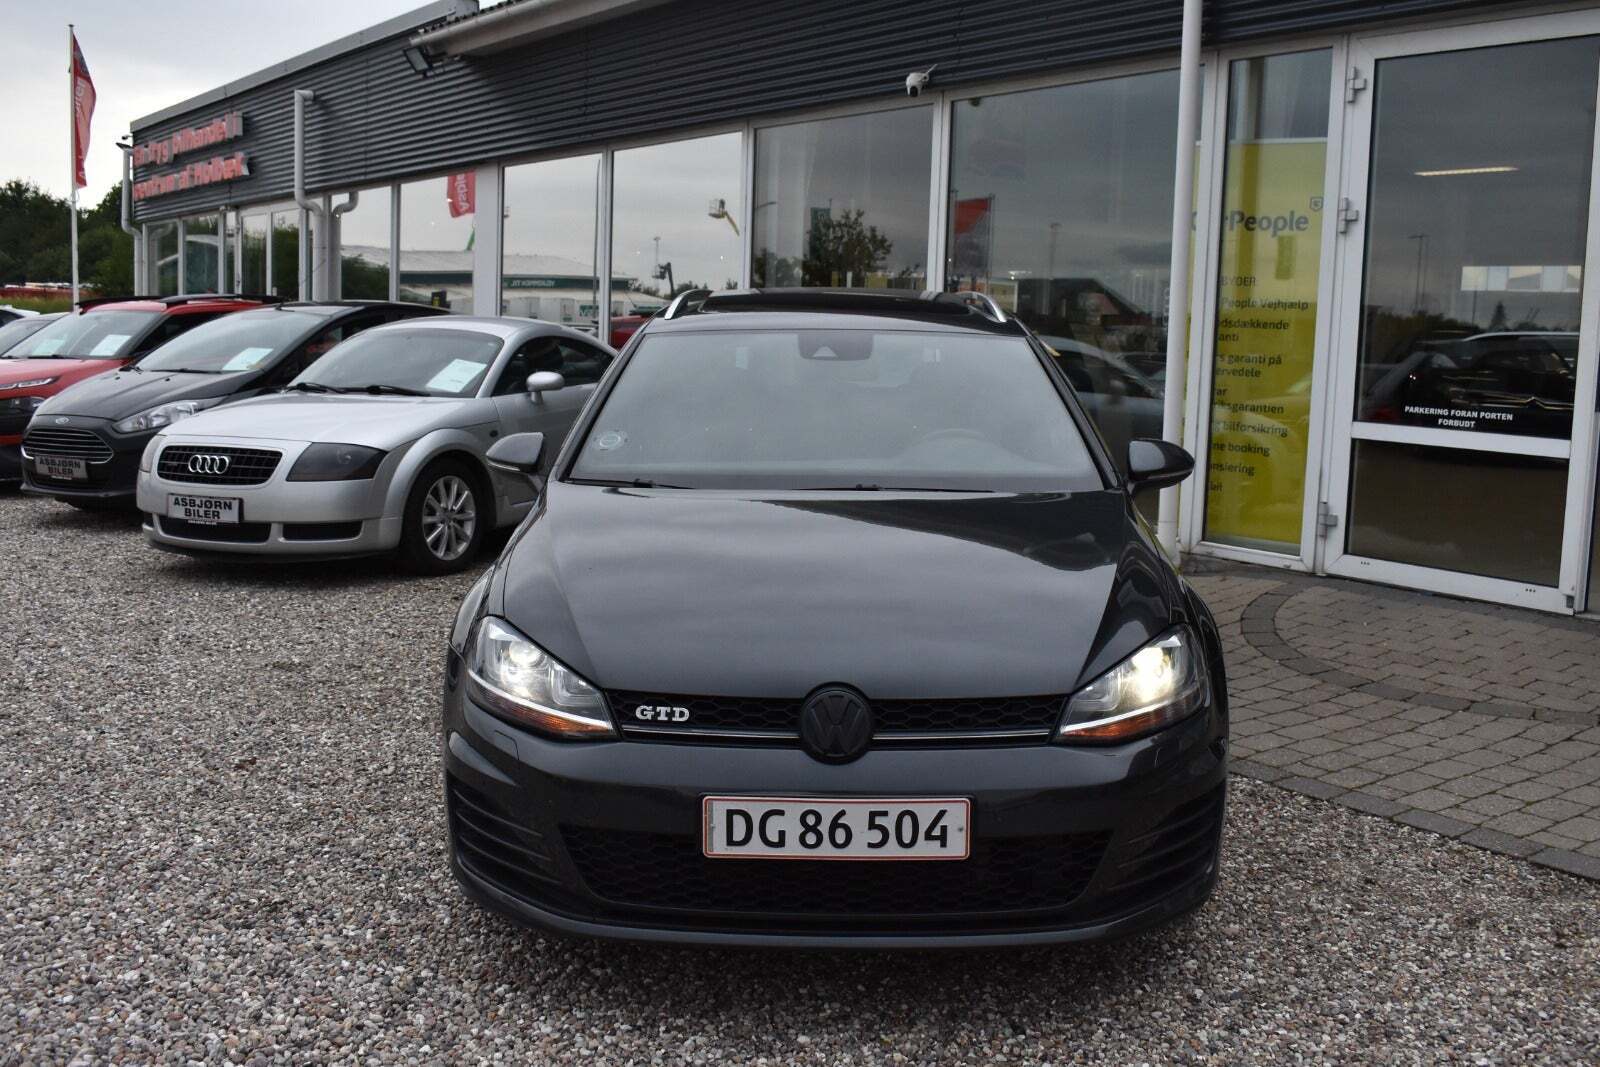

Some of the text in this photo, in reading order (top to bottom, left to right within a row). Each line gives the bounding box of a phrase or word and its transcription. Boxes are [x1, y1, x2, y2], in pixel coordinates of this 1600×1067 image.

[1261, 299, 1309, 312] Vejhjælp
[1219, 318, 1289, 330] dsdækkende
[1268, 354, 1282, 366] på
[1215, 367, 1261, 378] ervedele
[1404, 406, 1513, 421] PARKERING FORAN PORTEN
[1438, 418, 1476, 429] FORBUDT
[1227, 443, 1271, 457] booking
[173, 496, 233, 511] ASBJØRN
[184, 507, 221, 519] BILER
[635, 704, 690, 722] GTD
[725, 808, 948, 849] DG 86 504
